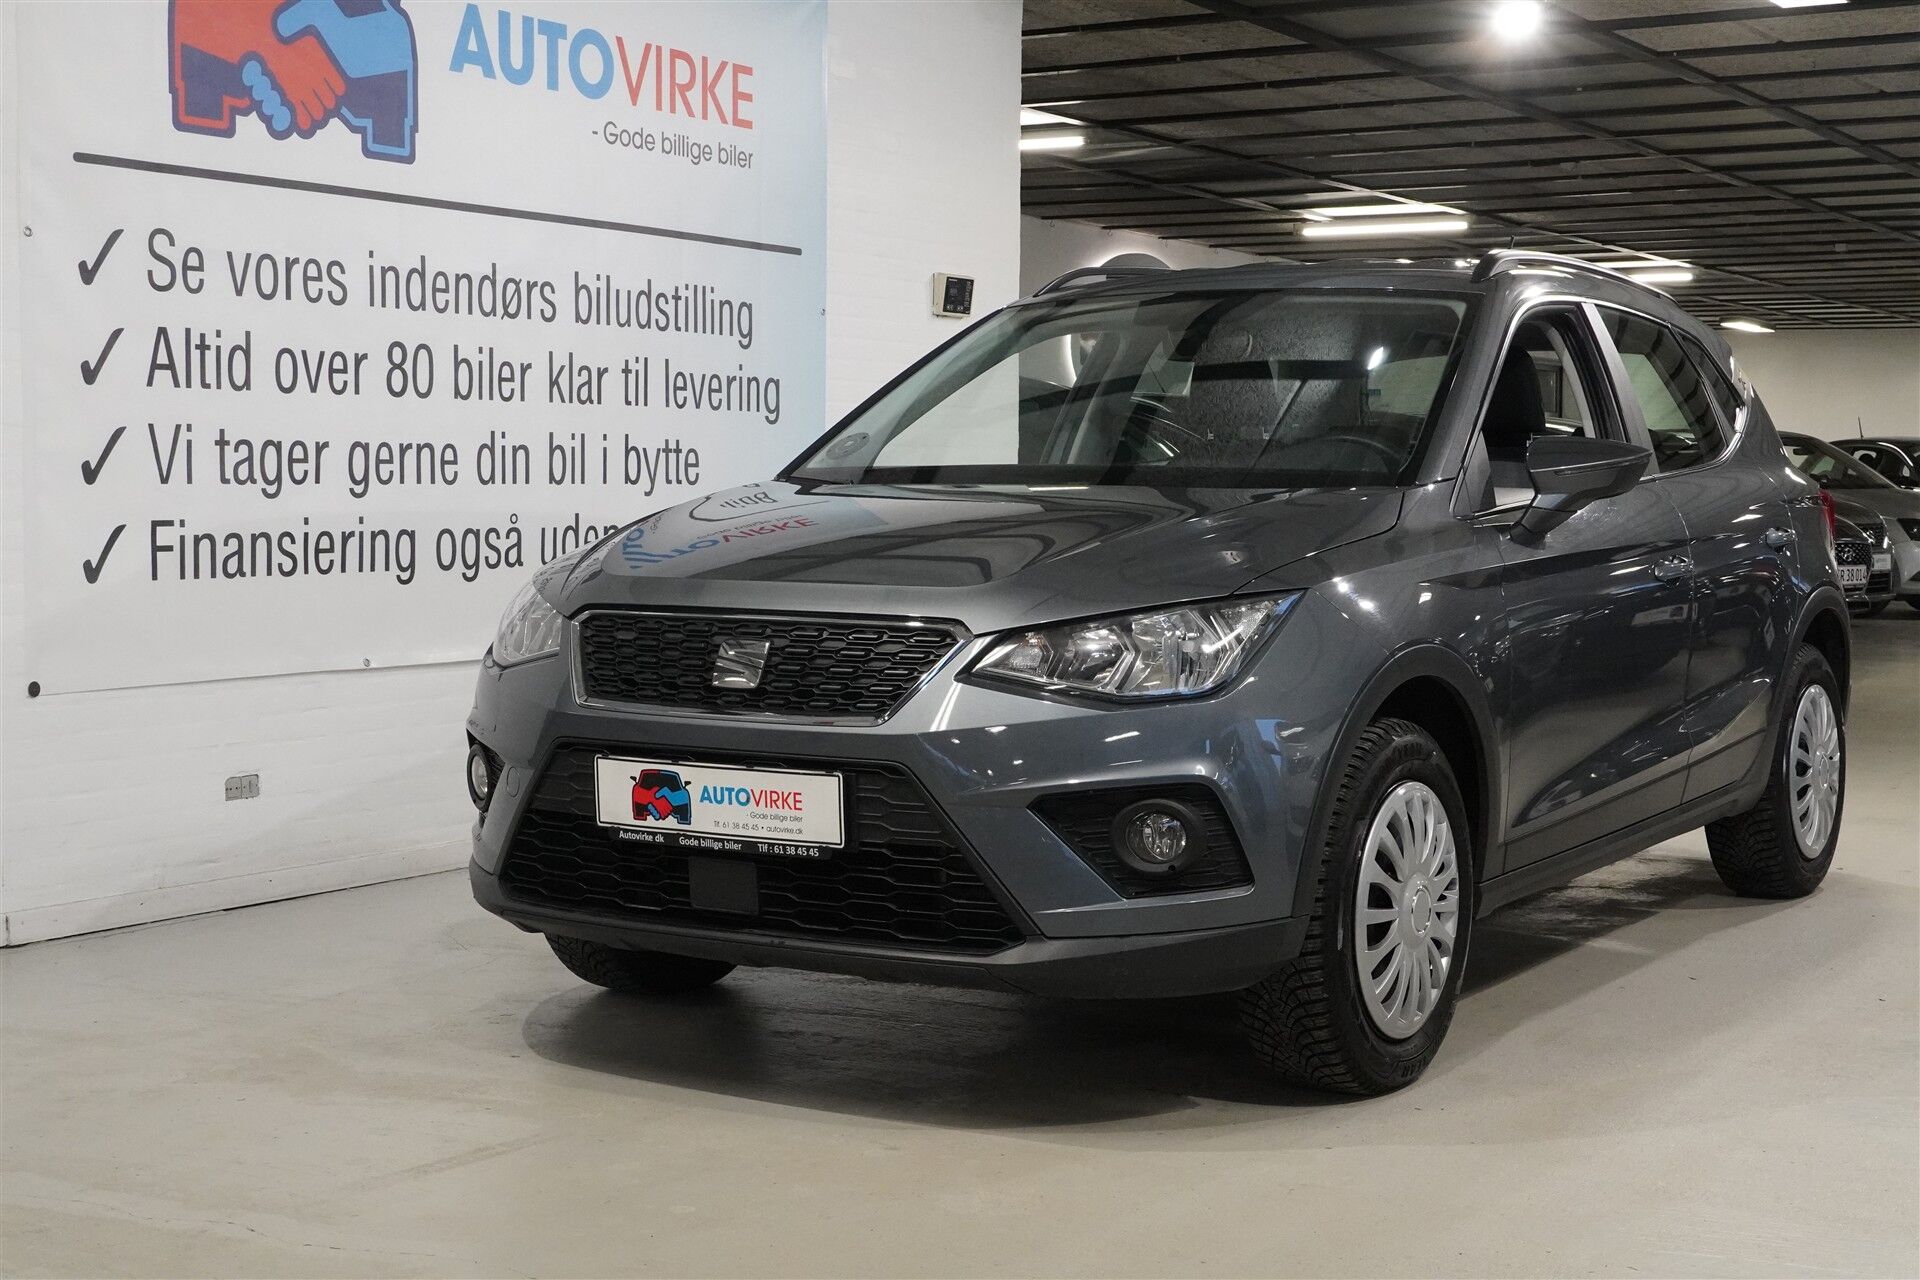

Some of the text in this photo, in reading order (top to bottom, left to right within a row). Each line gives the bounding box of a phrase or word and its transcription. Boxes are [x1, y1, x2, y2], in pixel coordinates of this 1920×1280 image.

[449, 2, 753, 130] AUTOVIRKE
[603, 120, 656, 151] Gode
[661, 131, 713, 166] billige
[718, 142, 754, 169] biler
[147, 227, 753, 350] Se vores indendørs biludstilling
[146, 326, 780, 425] Altid over 80 biler klar til levering
[148, 423, 700, 499] Vi tager gerne din bil i bytte
[150, 512, 620, 586] Finansiering også ude
[699, 785, 803, 811] AUTOVIRKE
[722, 821, 730, 829] 61
[731, 822, 740, 830] 38
[741, 822, 750, 831] 45
[750, 823, 760, 832] 45
[765, 824, 804, 835] autovirke.dk
[750, 811, 768, 820] Gode
[769, 813, 788, 823] billige
[789, 814, 803, 823] biler
[619, 830, 653, 842] Autovirke
[654, 833, 665, 843] dk
[679, 836, 699, 847] Gode
[700, 838, 723, 850] billige
[724, 842, 742, 851] biler
[757, 843, 769, 853] Tlf
[774, 845, 784, 854] 61
[785, 845, 796, 855] 38
[797, 846, 807, 856] 45
[808, 847, 819, 857] 45
